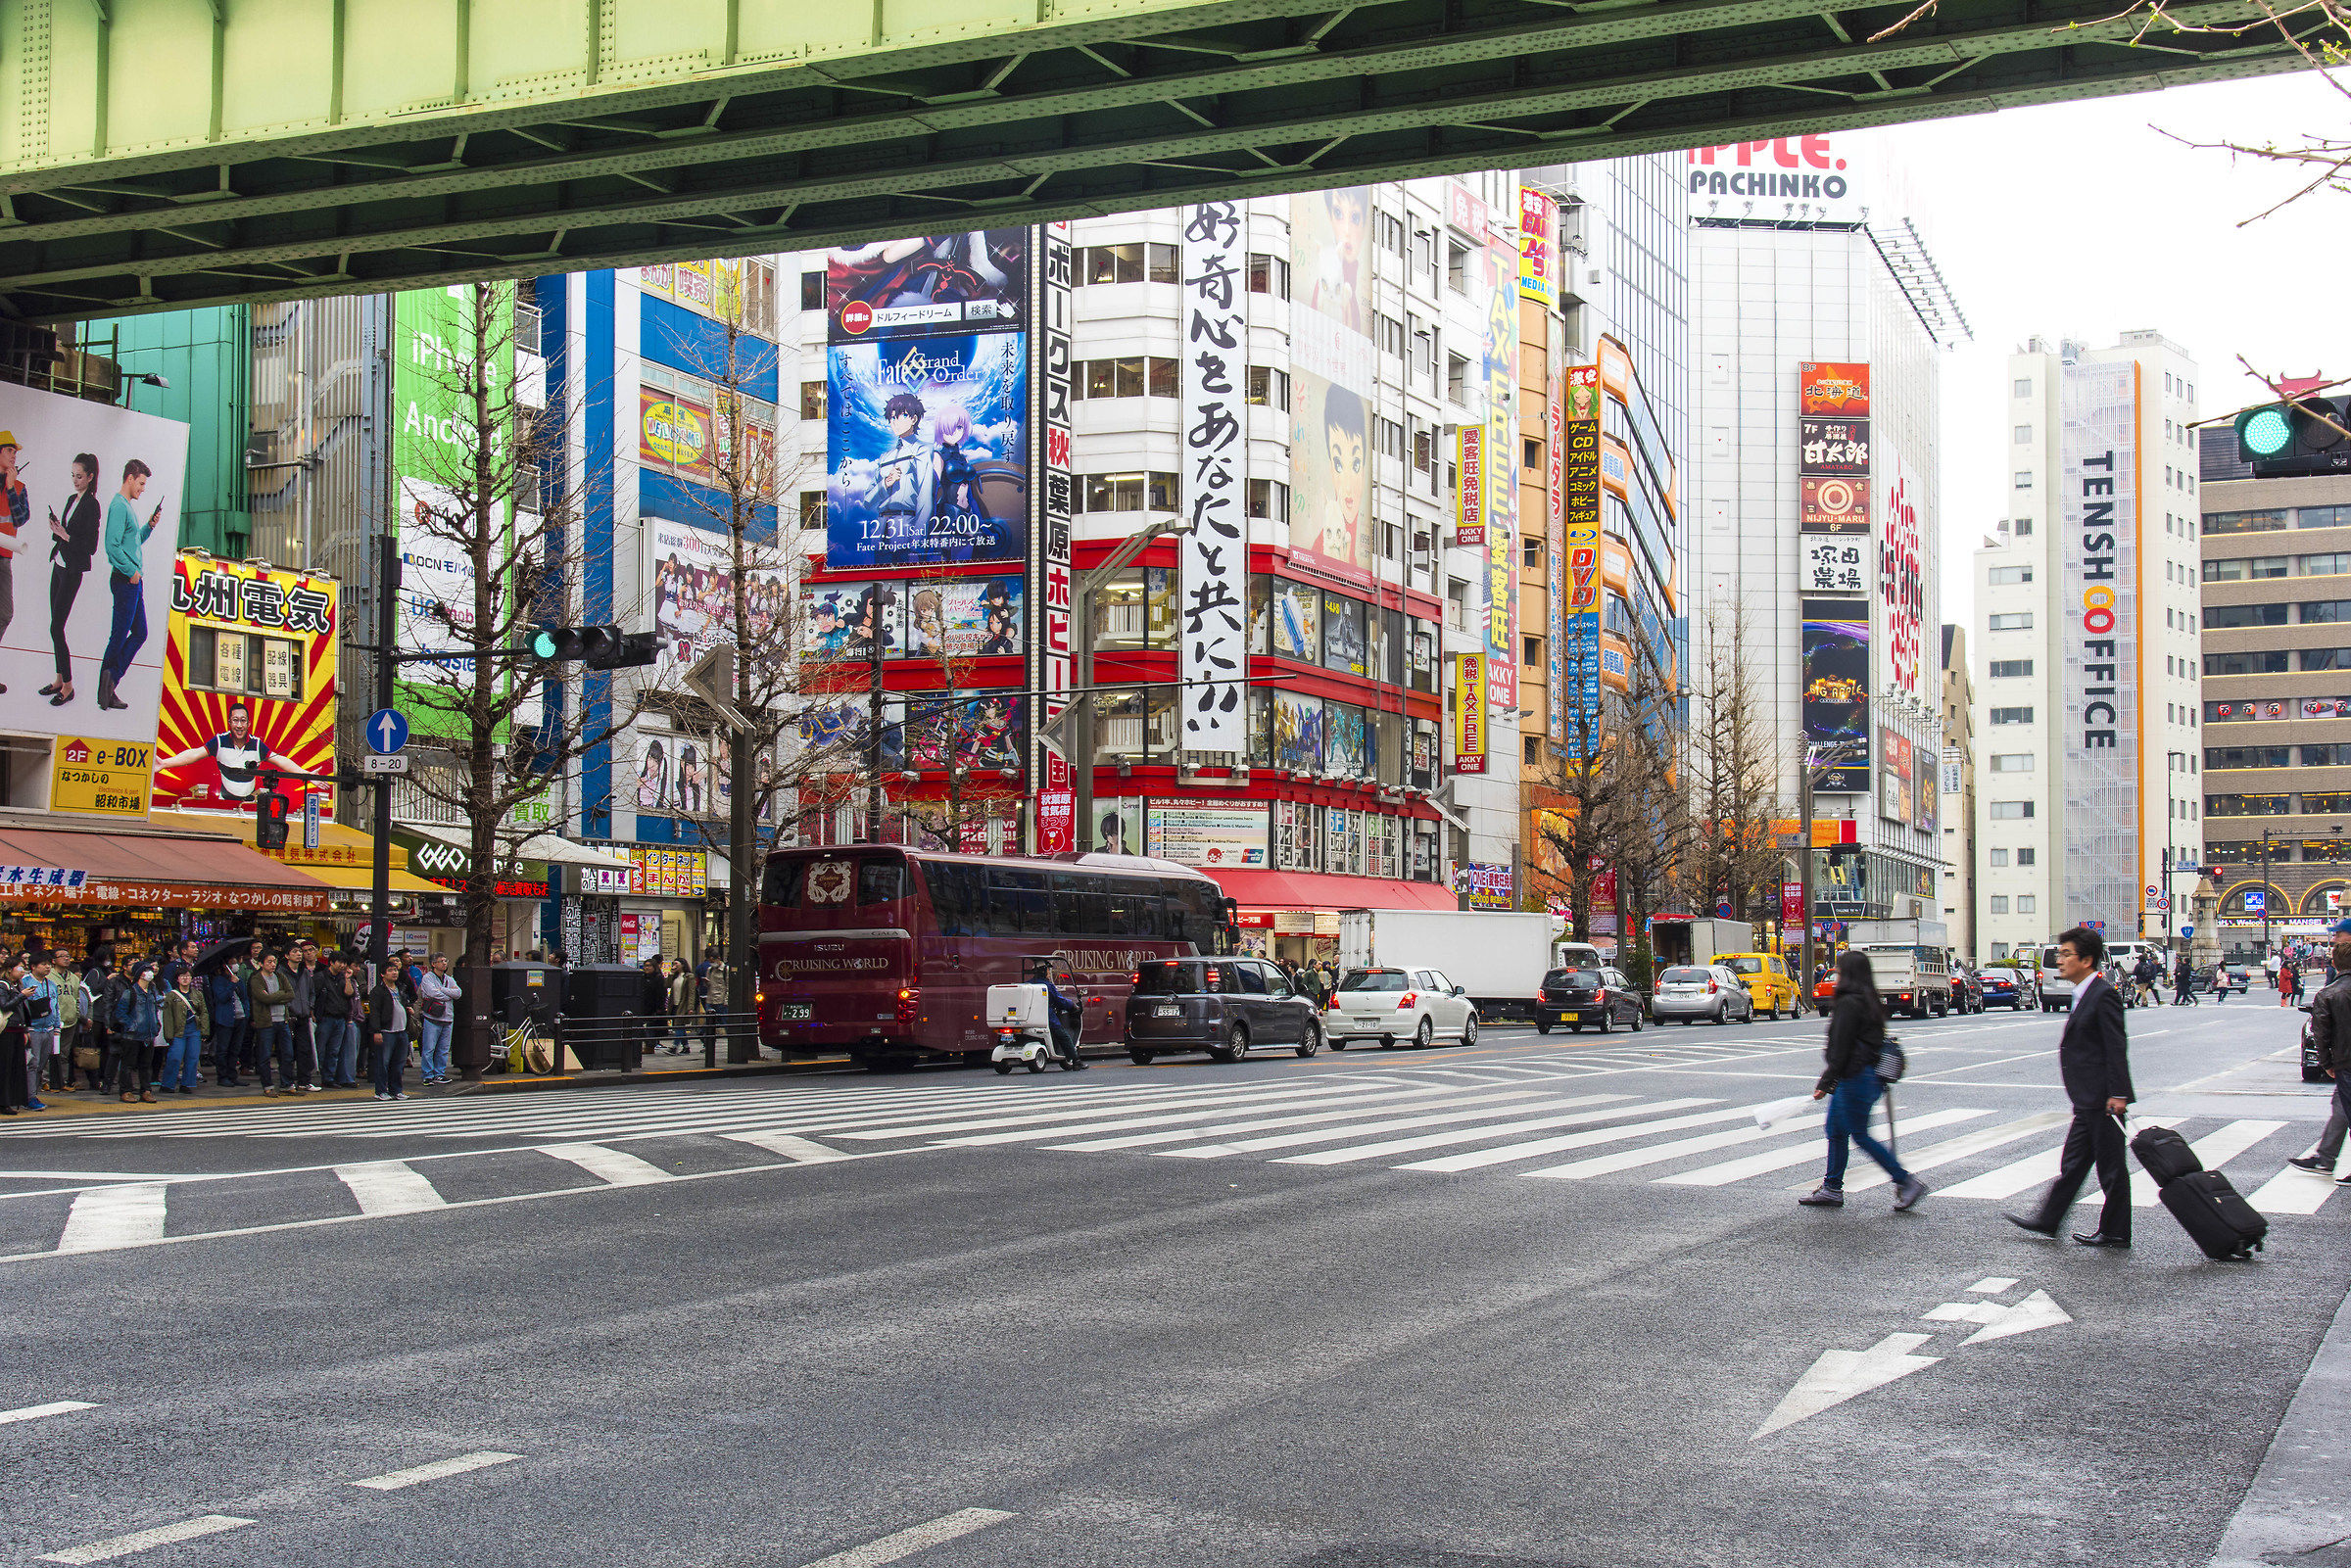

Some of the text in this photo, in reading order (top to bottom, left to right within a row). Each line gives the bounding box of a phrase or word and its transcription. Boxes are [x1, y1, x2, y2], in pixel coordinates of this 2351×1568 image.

[1690, 169, 1847, 199] PACHINKO
[1454, 193, 1486, 236] 免税
[1521, 276, 1545, 294] MEDIA
[876, 309, 953, 322] ドルフィードリーム
[970, 305, 992, 316] 検索
[912, 351, 961, 369] Grand
[878, 359, 910, 386] Fate
[933, 366, 982, 383] Order
[1569, 368, 1598, 387] 激安
[1490, 250, 1511, 515] TAX FREE
[840, 354, 853, 488] すべてはここから
[1569, 421, 1597, 434] ゲーム
[1803, 424, 1819, 434] 7F
[1572, 436, 1594, 449] CD
[1568, 450, 1598, 463] アイドル
[1802, 440, 1869, 466] 甘太郎
[1568, 465, 1598, 479] アニメ
[1602, 451, 1625, 482] SEGA
[1463, 427, 1480, 524] 愛客旺免税店
[1569, 480, 1597, 493] コミック
[1569, 496, 1596, 508] ホビー
[1568, 510, 1597, 523] フィギュア
[1806, 514, 1865, 523] NIJYU-MARU
[1459, 527, 1483, 536] AKKY
[1829, 523, 1843, 532] 6F
[856, 542, 876, 552] Fate
[416, 555, 442, 571] OCN
[1810, 545, 1860, 566] 塚田
[1569, 547, 1597, 608] DVD
[1463, 656, 1479, 680] 免税
[1602, 647, 1626, 678] SEGA
[1488, 660, 1513, 686] AKKY
[1489, 686, 1511, 706] ONE
[1463, 683, 1479, 753] TAX FREE
[67, 746, 149, 769] 2F e-BOX
[1458, 755, 1482, 764] AKKY
[61, 771, 110, 784] なつかしの
[95, 793, 141, 810] 昭和市場
[1040, 793, 1072, 806] 秋葉原
[1040, 805, 1071, 817] 電気街
[1040, 816, 1070, 828] まつり
[648, 872, 691, 885] まんが
